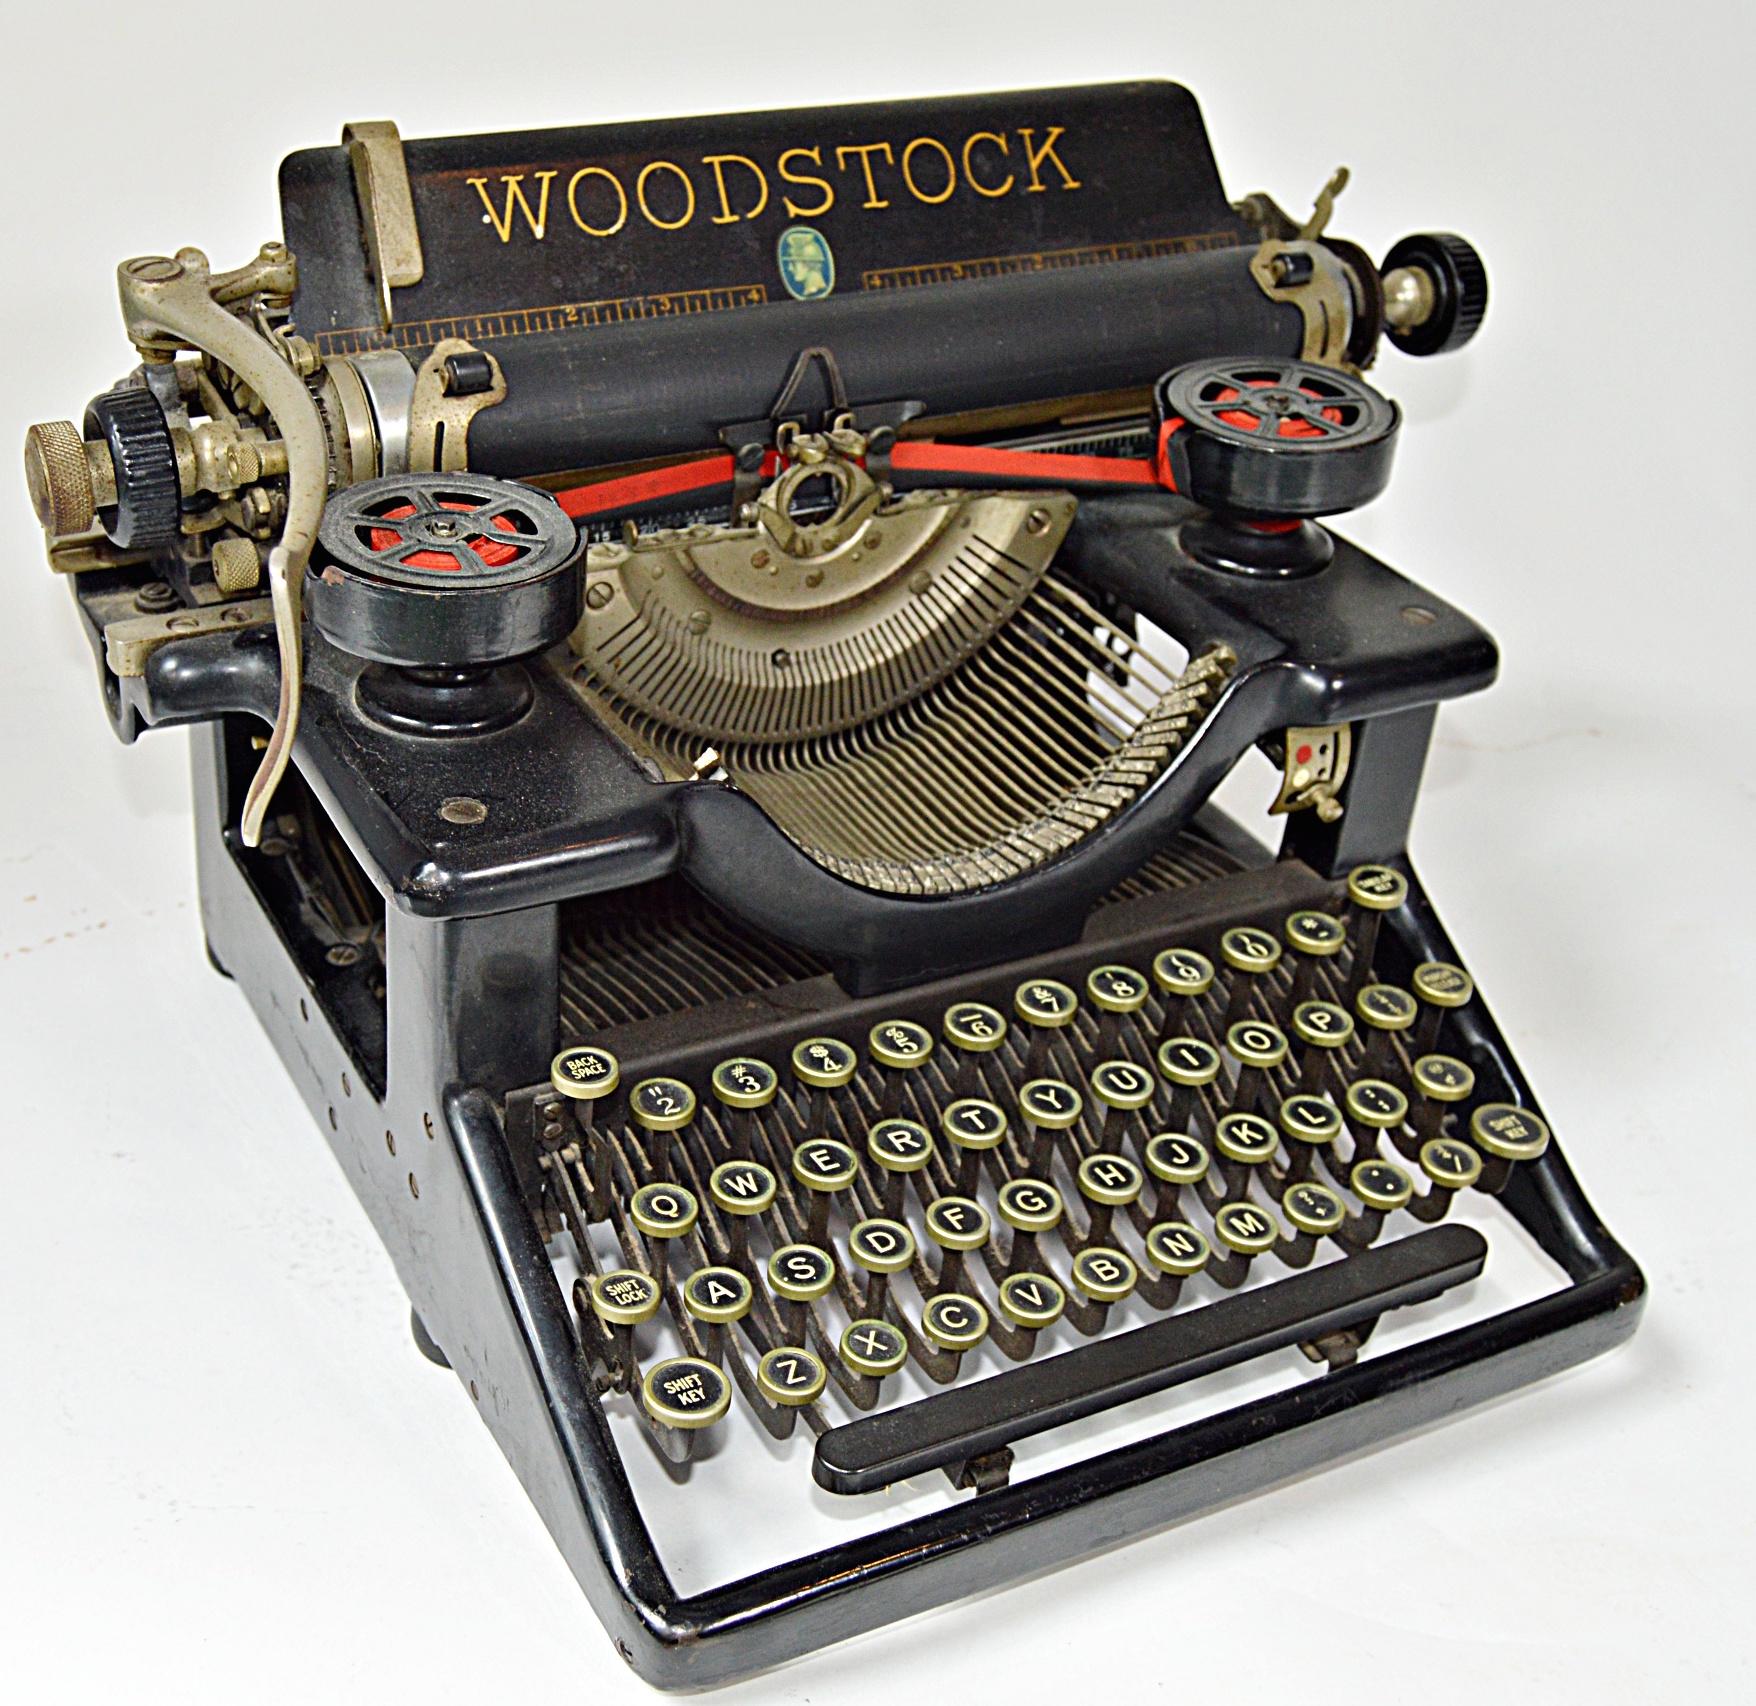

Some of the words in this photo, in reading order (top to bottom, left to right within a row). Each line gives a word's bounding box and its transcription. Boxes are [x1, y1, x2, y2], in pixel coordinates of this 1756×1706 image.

[466, 127, 1082, 243] WOODSTOCK
[1308, 1011, 1331, 1031] P
[1243, 1030, 1271, 1050] O
[566, 1055, 598, 1070] BACK
[1180, 1049, 1199, 1066] I
[571, 1063, 607, 1079] SPACE
[1109, 1070, 1137, 1090] U
[1035, 1089, 1062, 1109] Y
[960, 1109, 990, 1130] T
[1298, 1107, 1326, 1124] L
[887, 1130, 919, 1152] R
[1231, 1123, 1264, 1144] K
[811, 1149, 840, 1171] E
[1171, 1143, 1190, 1164] J
[724, 1172, 758, 1196] W
[1094, 1164, 1126, 1186] H
[651, 1195, 679, 1218] Q
[1016, 1191, 1047, 1211] G
[943, 1208, 966, 1230] F
[1229, 1212, 1265, 1236] M
[865, 1231, 896, 1253] D
[1163, 1233, 1195, 1256] N
[788, 1257, 816, 1279] S
[1089, 1259, 1120, 1281] B
[605, 1279, 640, 1296] SHIFT
[615, 1288, 649, 1305] LOCK
[708, 1281, 736, 1304] A
[1015, 1284, 1043, 1306] V
[940, 1307, 969, 1329] C
[853, 1330, 887, 1355] X
[776, 1358, 806, 1385] Z
[664, 1373, 702, 1394] SHIFT
[677, 1387, 706, 1406] KEY
